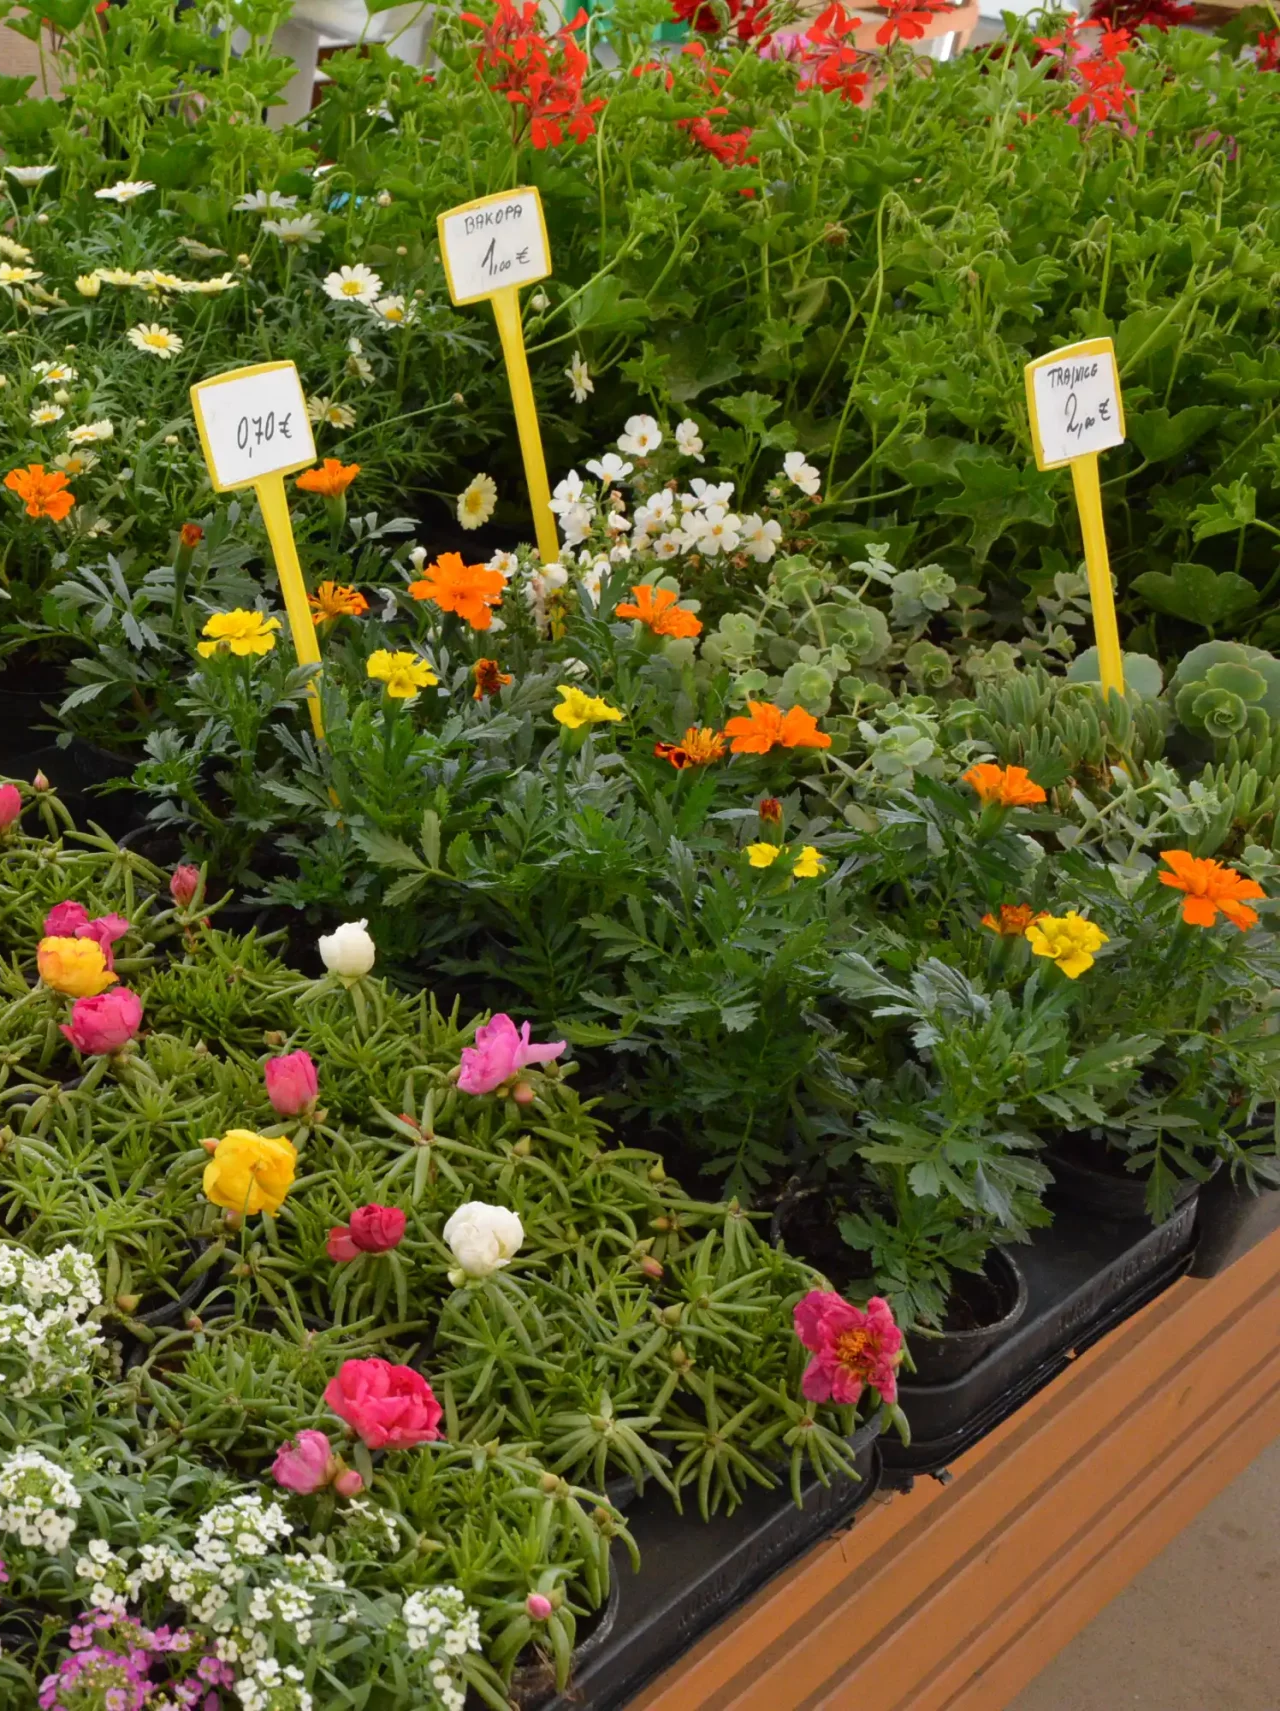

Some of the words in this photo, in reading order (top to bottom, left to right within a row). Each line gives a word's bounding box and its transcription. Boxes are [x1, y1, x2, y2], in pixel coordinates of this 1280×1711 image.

[464, 204, 522, 236] BAKOPA
[481, 237, 511, 276] 1,00
[516, 246, 531, 264] €
[1065, 392, 1095, 440] 2,00
[1099, 397, 1111, 421] €
